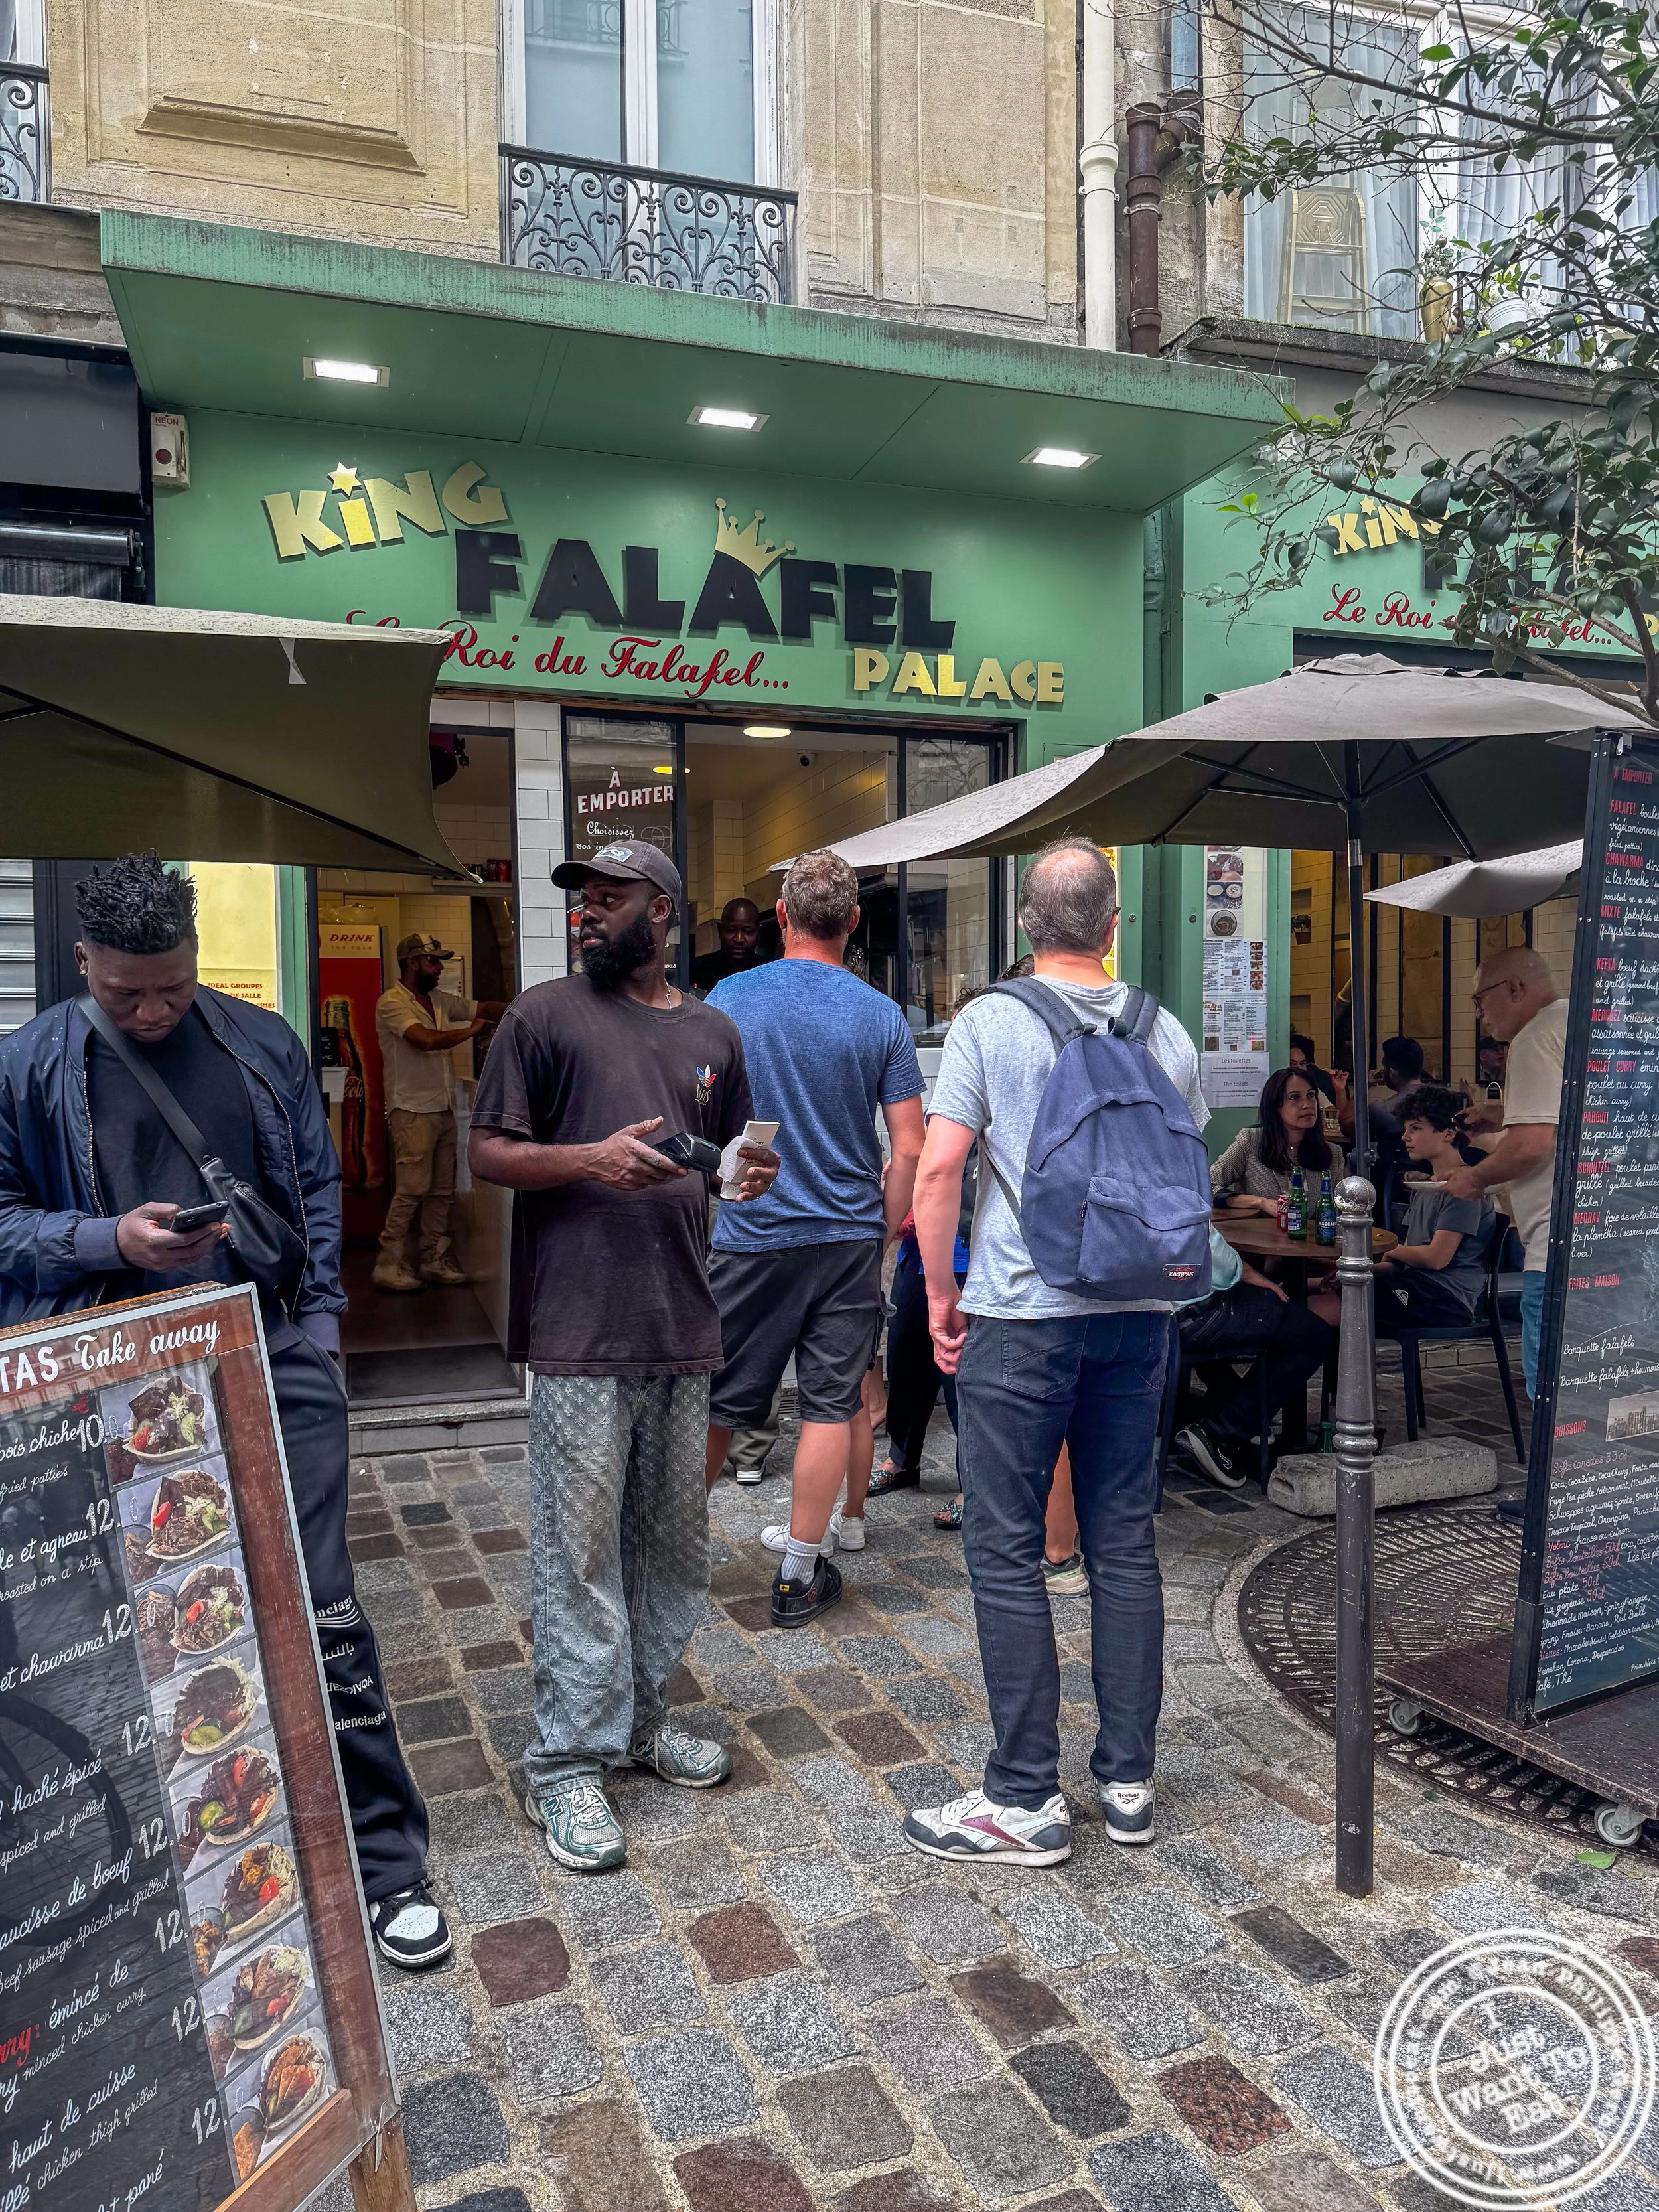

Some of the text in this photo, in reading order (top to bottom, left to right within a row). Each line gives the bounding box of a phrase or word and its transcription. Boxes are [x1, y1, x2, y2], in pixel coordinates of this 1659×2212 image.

[455, 529, 956, 648] FALAFEL
[1322, 583, 1365, 622] Le
[1376, 591, 1435, 629] Roi
[441, 619, 519, 671] Roi
[534, 636, 587, 676] du
[853, 648, 1064, 702] PALACE
[609, 766, 622, 788] À
[1621, 768, 1653, 784] EMPORTER
[577, 785, 674, 814] EMPORTER
[1609, 799, 1636, 816] FALAFEL
[587, 818, 635, 840] Choisissez
[1605, 852, 1644, 869] CHAWARMA
[1613, 869, 1623, 885] la
[1623, 869, 1650, 887] broche
[1600, 904, 1652, 926] MIXTE falafels
[1595, 958, 1616, 971] KEFTA
[1595, 973, 1626, 995] et grillé
[1623, 1013, 1654, 1023] saucisse
[1591, 1023, 1643, 1039] assaisonnée et
[1587, 1060, 1636, 1073] POULET CURRY
[1587, 1074, 1615, 1096] poulet
[1630, 1080, 1653, 1096] curry
[1613, 1110, 1634, 1123] haut
[1638, 1111, 1649, 1122] de
[1581, 1127, 1593, 1140] de
[1592, 1126, 1624, 1145] poulet
[1577, 1159, 1642, 1178] SCHNITZEL poulet
[1575, 1173, 1603, 1199] grillé
[1605, 1209, 1620, 1231] foie
[1620, 1210, 1630, 1221] de
[1573, 1224, 1619, 1248] la plancha
[1568, 1273, 1621, 1291] FRITES MAISON
[74, 1330, 136, 1372] Take
[150, 1319, 221, 1355] away
[1563, 1334, 1636, 1362] Barquette falafels
[1560, 1364, 1629, 1393] Barquette falafels
[1553, 1419, 1587, 1439] BOISSONS
[30, 1463, 69, 1493] patties
[21, 1537, 38, 1563] et
[40, 1529, 88, 1564] agneau
[40, 1574, 57, 1587] on
[61, 1567, 72, 1580] a
[77, 1553, 104, 1576] stip
[1559, 1582, 1580, 1599] plate
[1613, 1605, 1646, 1623] Red Bull
[0, 1635, 106, 1692] et chawarma
[334, 1710, 387, 1731] alenciaga
[11, 1747, 102, 1814] haché épicé
[0, 1793, 107, 1874] spiced and grilled
[68, 1876, 88, 1907] de
[23, 1936, 72, 1978] sausage
[74, 1903, 113, 1948] spiced
[114, 1899, 130, 1920] and
[132, 1867, 170, 1917] grilled
[48, 1972, 100, 2029] émincé
[109, 1958, 129, 1988] de
[22, 2035, 66, 2081] minced
[71, 2010, 112, 2045] chicken
[116, 1986, 147, 2014] curry
[9, 2063, 137, 2174] haut de cuisse
[36, 2146, 84, 2191] chicken
[88, 2108, 121, 2150] thigh
[124, 2077, 159, 2128] grilled
[124, 2147, 165, 2212] pané
